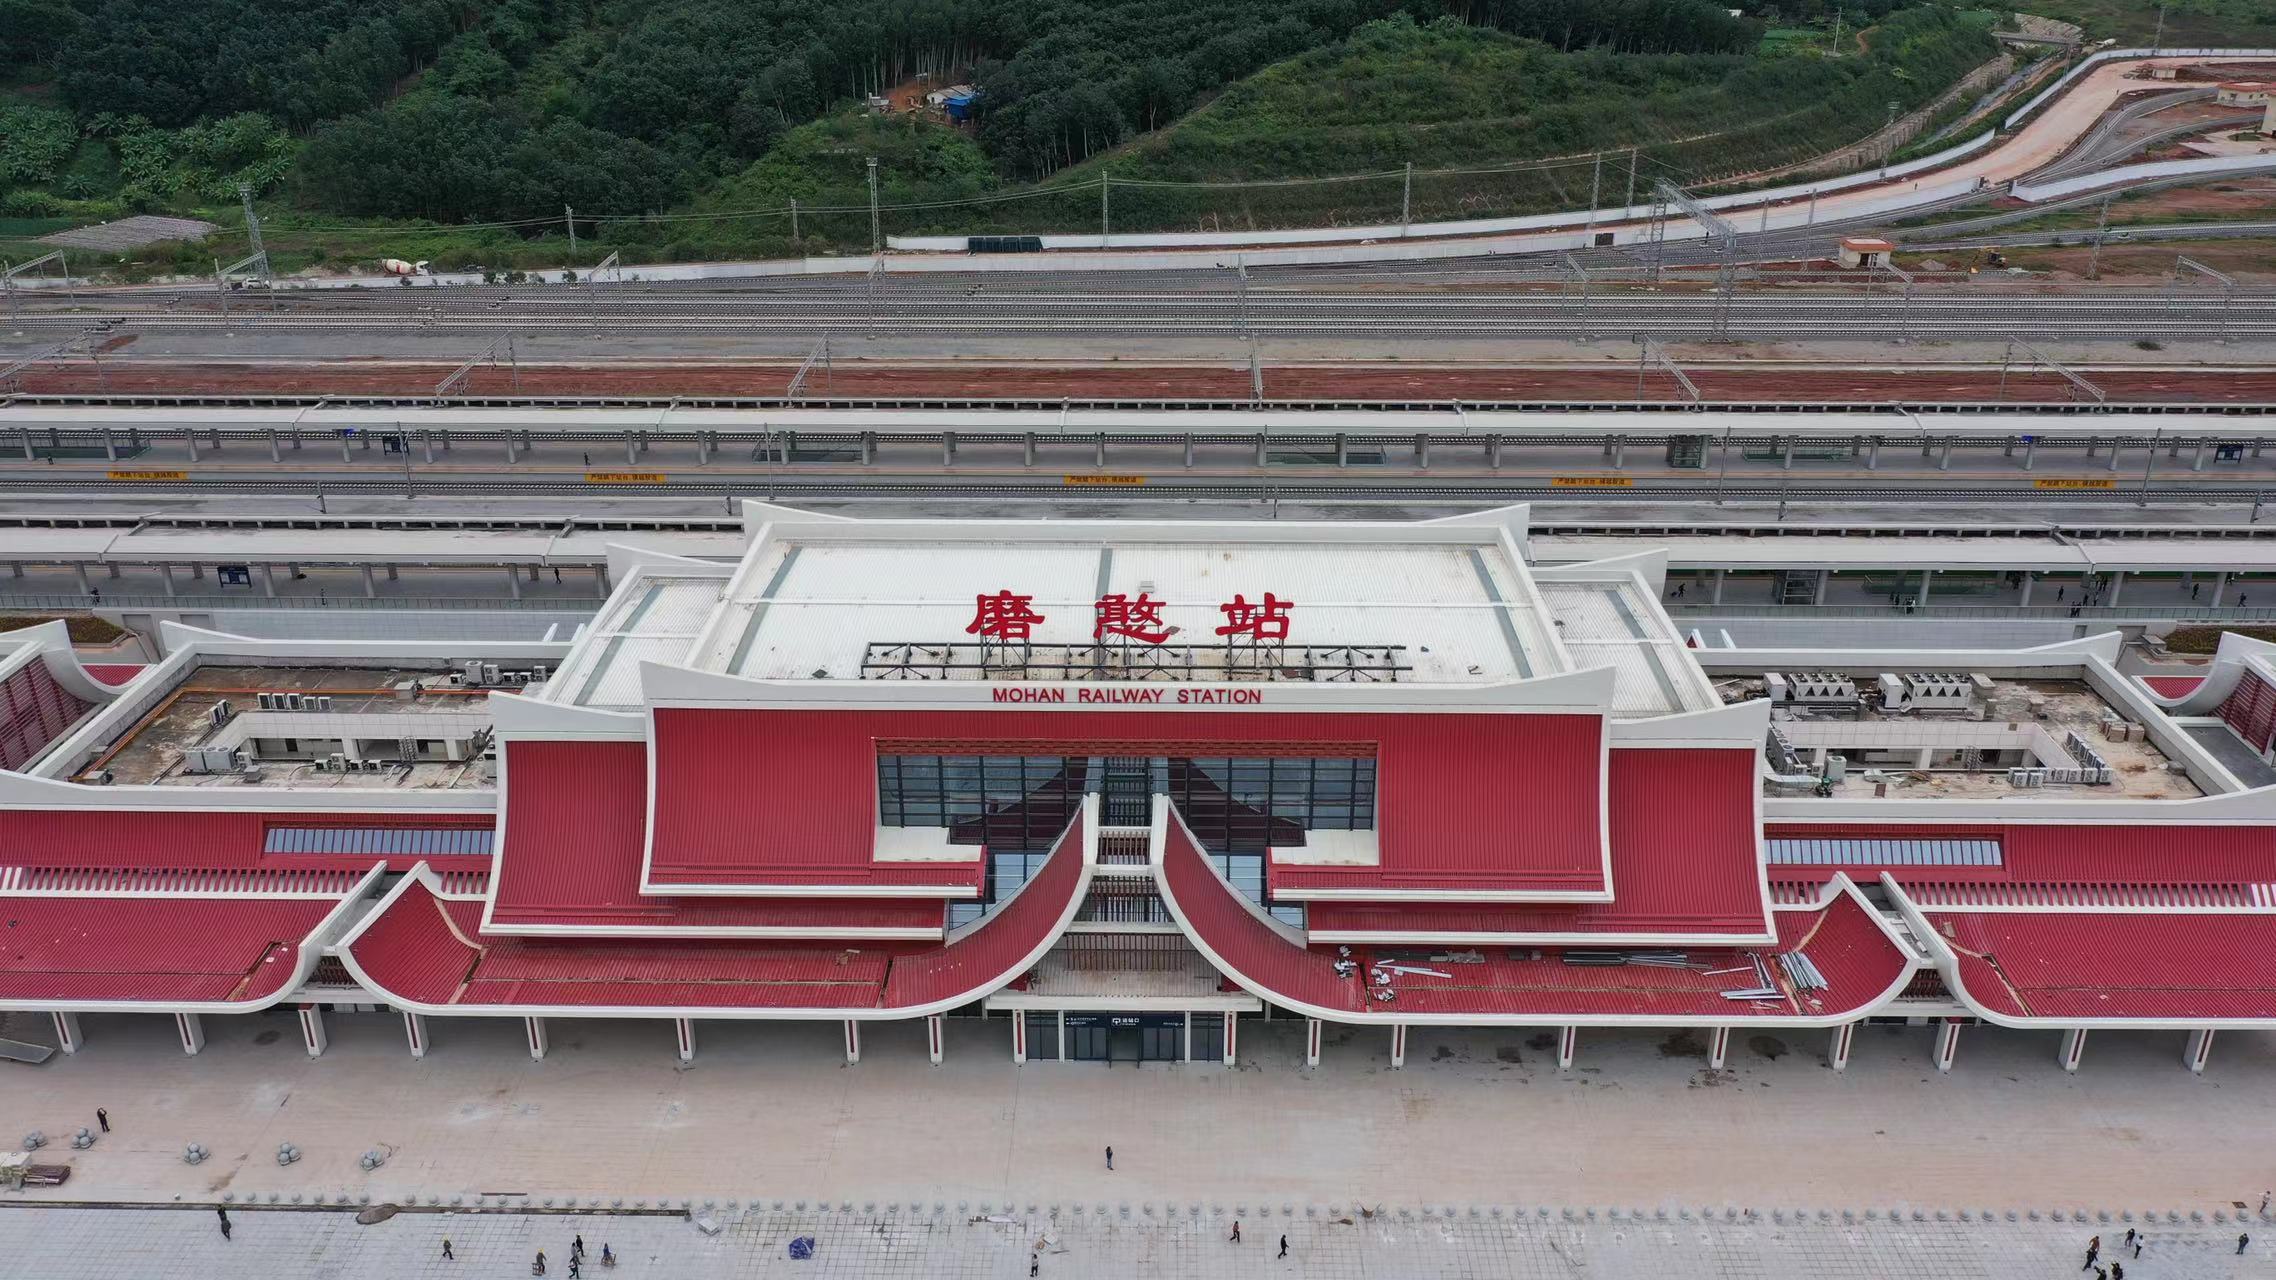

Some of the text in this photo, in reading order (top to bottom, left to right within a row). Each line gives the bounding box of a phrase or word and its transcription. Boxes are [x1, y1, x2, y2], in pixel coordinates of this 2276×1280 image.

[965, 588, 1297, 645] 磨憨站
[992, 686, 1264, 705] MOHAN RAILWAY STATION
